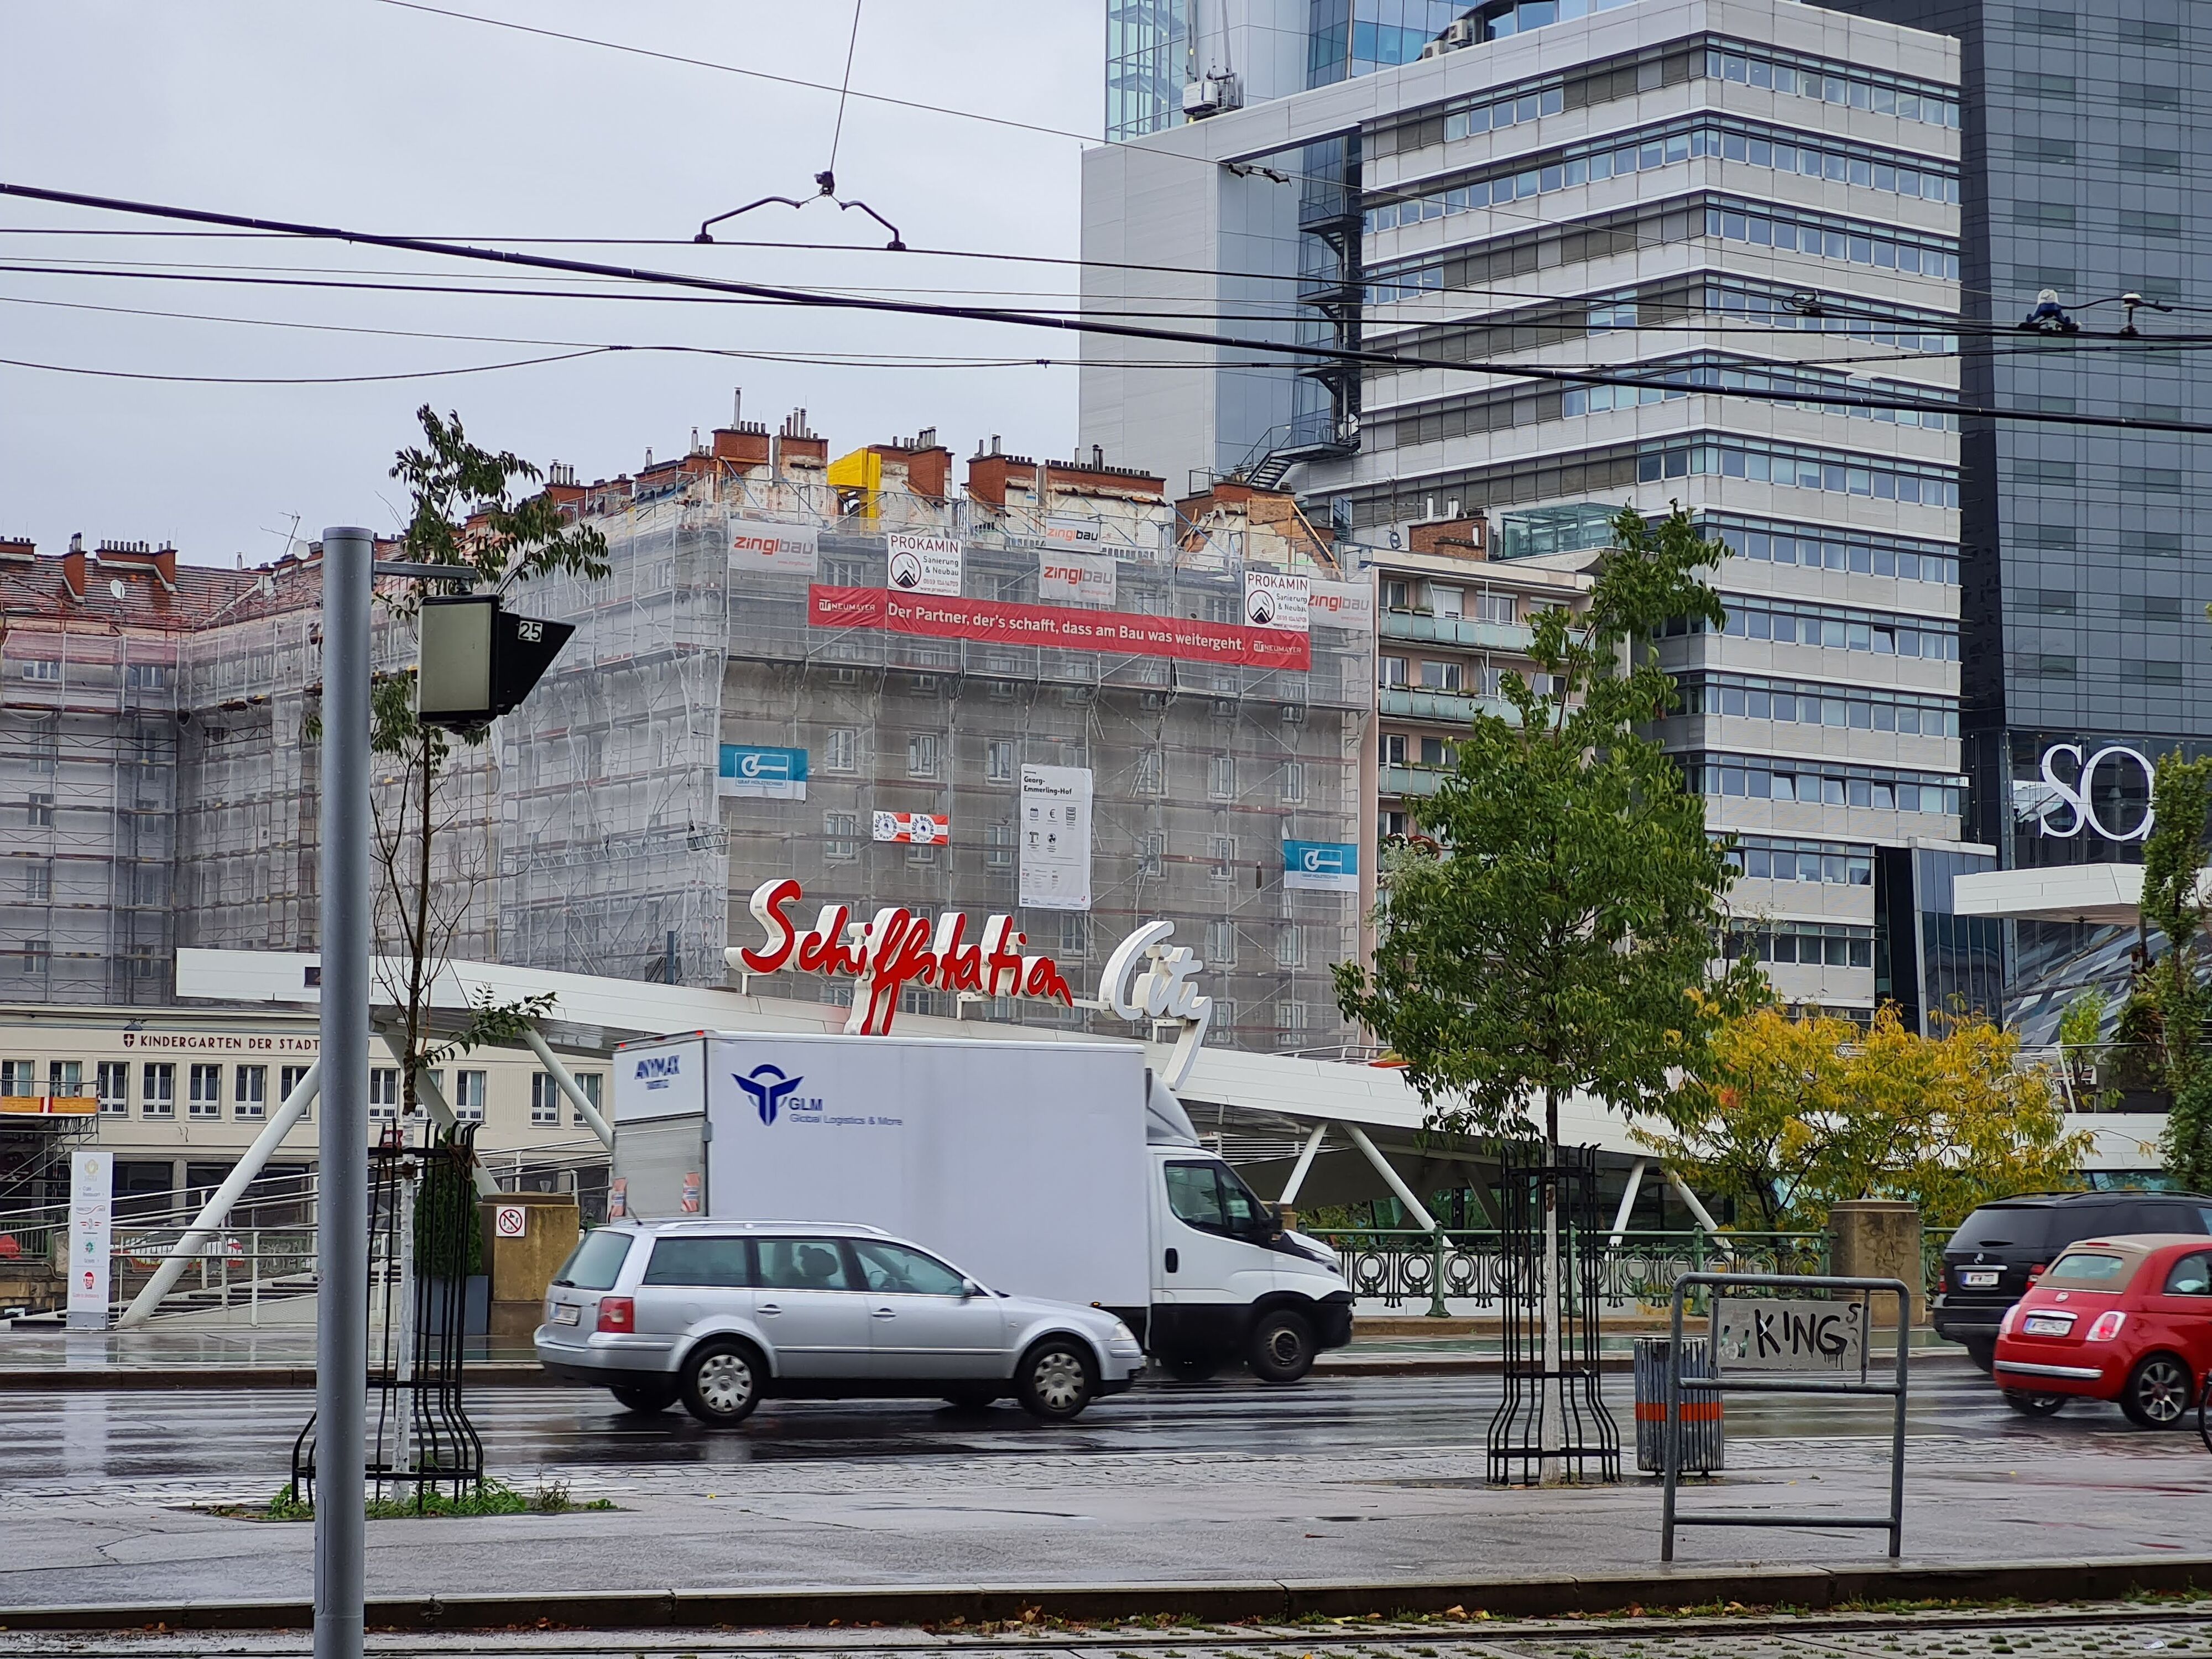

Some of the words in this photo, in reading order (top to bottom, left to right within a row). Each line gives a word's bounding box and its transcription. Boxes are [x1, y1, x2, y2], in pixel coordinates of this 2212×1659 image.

[1047, 528, 1098, 541] zinglbau
[734, 536, 813, 555] zinglbau
[890, 535, 958, 554] PROKAMIN
[923, 555, 959, 567] Sanierung
[932, 567, 959, 576] Neubau
[1044, 566, 1113, 585] zinglbau
[1248, 573, 1308, 591] PROKAMIN
[1276, 593, 1307, 603] Sanierung
[1308, 595, 1369, 612] zinglbau
[831, 603, 875, 611] NEUMAYER
[519, 622, 541, 640] 25
[888, 602, 912, 619] Der
[916, 607, 970, 626] Partner,
[1009, 618, 1059, 635] schafft,
[1062, 620, 1093, 636] dass
[1095, 626, 1115, 638] am
[1119, 625, 1144, 640] Bau
[1148, 630, 1173, 643] was
[1176, 633, 1245, 651] weitergeht.
[1264, 644, 1302, 654] NEUMAYER
[1024, 775, 1045, 785] Georg-
[1024, 785, 1072, 796] Emmerling-Hof
[739, 878, 1073, 1036] Schiffstation
[1100, 920, 1212, 1091] City
[140, 1035, 242, 1049] KINDERGARTEN
[248, 1037, 272, 1050] DER
[279, 1039, 320, 1050] STADT
[789, 1097, 823, 1111] GLM
[789, 1113, 820, 1123] Global
[823, 1115, 865, 1126] Logistics
[868, 1116, 875, 1125] &
[878, 1117, 903, 1126] More
